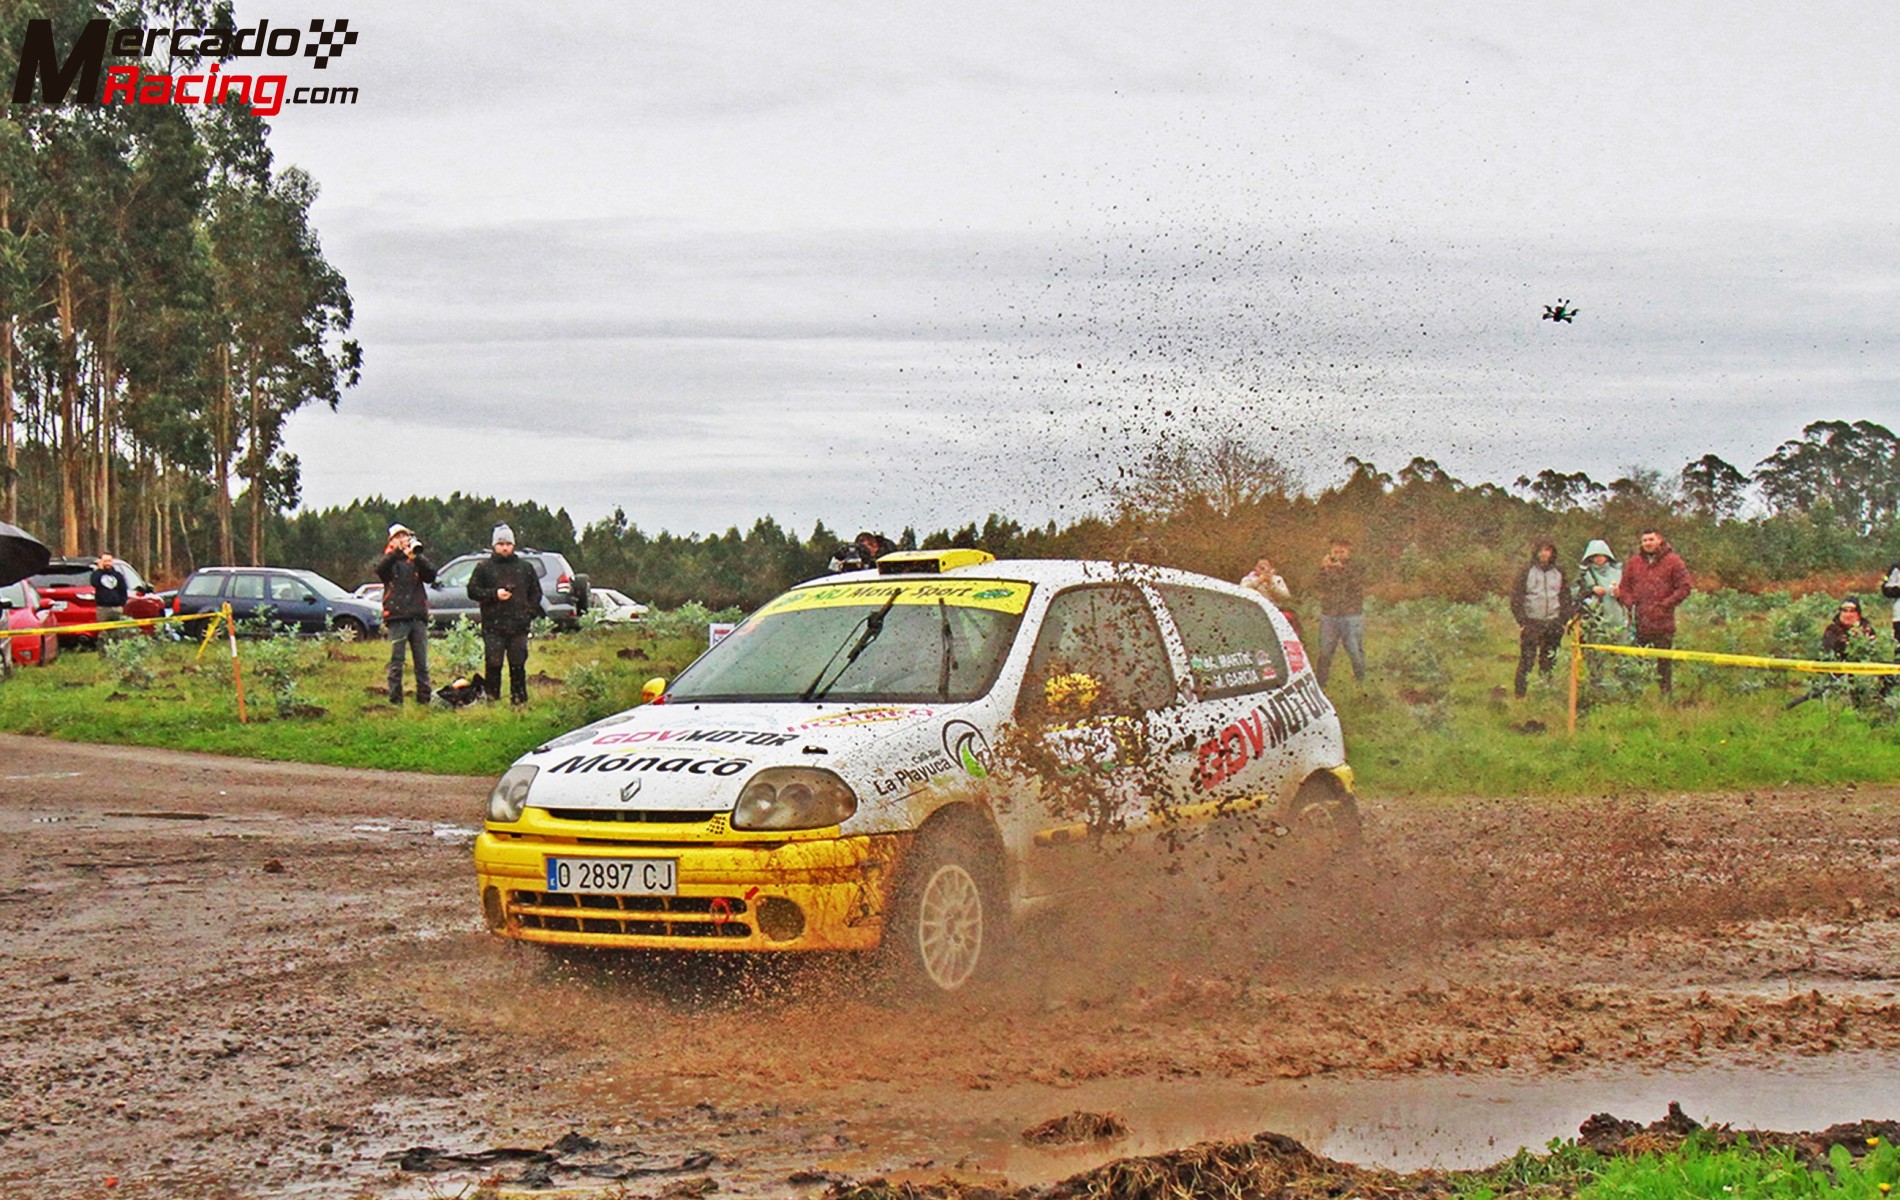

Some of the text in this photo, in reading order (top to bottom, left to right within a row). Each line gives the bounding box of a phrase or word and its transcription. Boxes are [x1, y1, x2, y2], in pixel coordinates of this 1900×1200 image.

[911, 585, 973, 599] Sport
[873, 758, 953, 796] La Playuca
[578, 863, 633, 889] 2897
[643, 864, 672, 890] CJ
